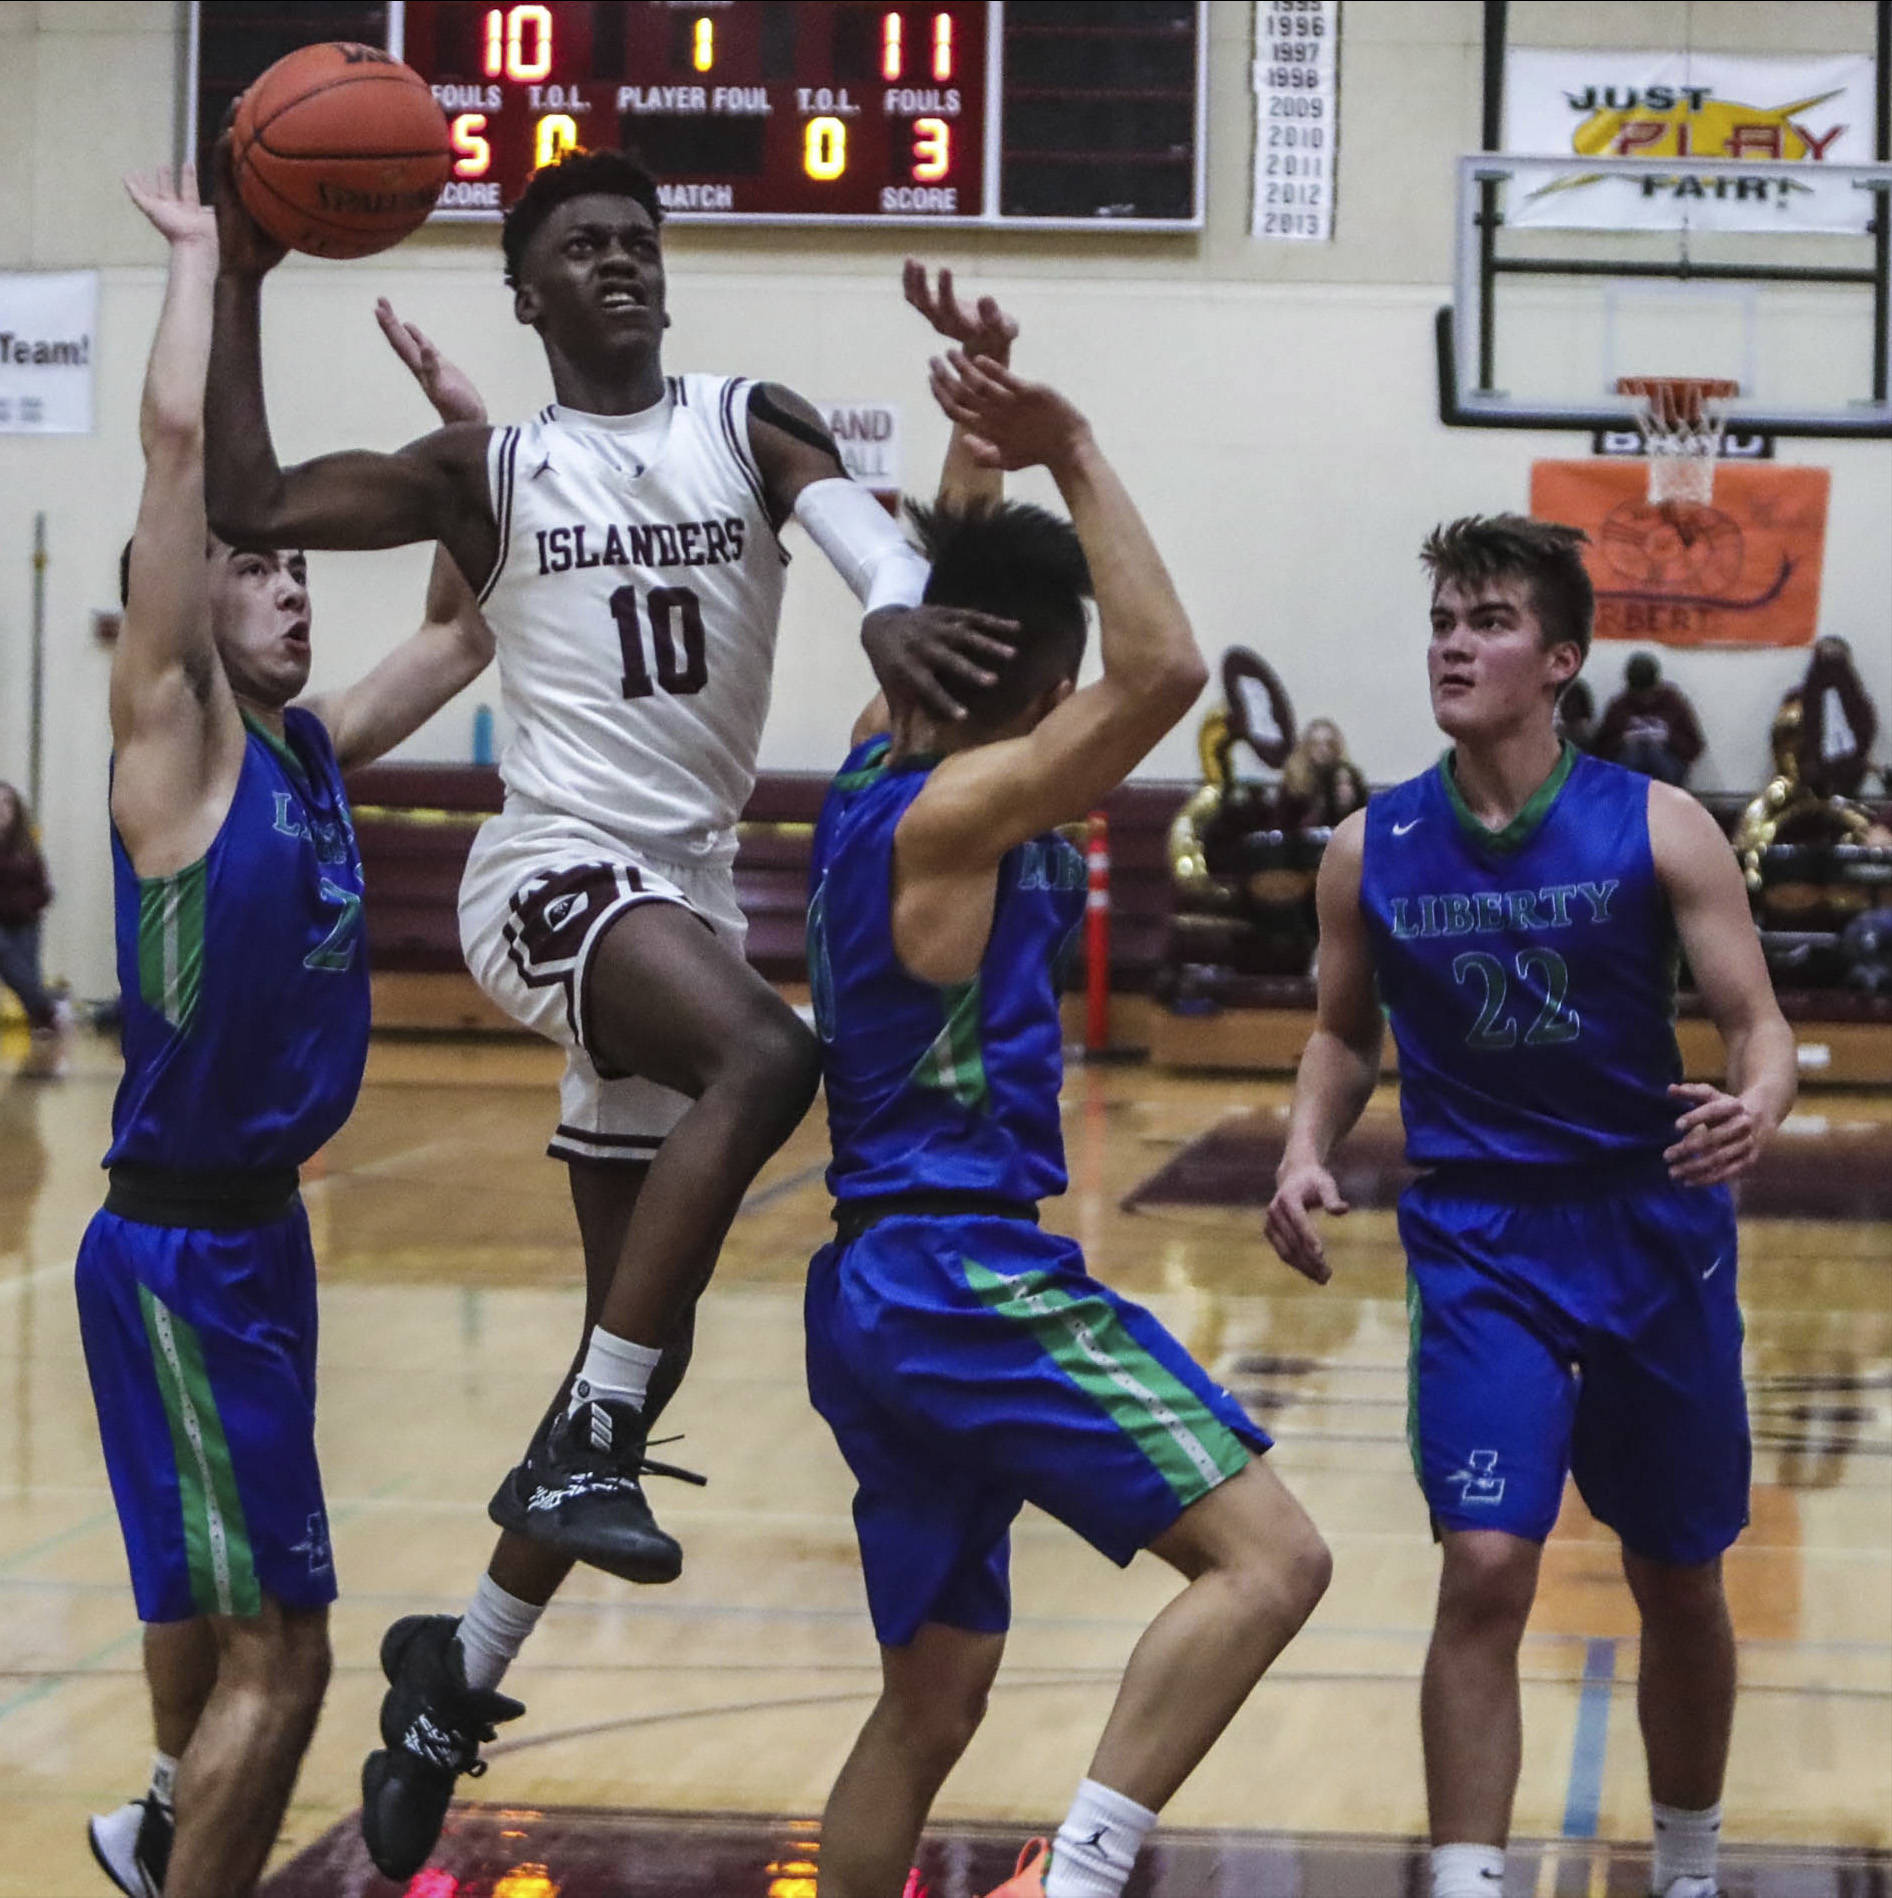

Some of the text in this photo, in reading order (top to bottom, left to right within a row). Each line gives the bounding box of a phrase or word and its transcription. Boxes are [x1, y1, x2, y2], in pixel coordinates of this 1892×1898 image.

[1268, 16, 1324, 37] 1996
[484, 4, 552, 81] 10
[693, 17, 713, 72] 1
[883, 12, 951, 81] 11
[1273, 43, 1319, 62] 1997
[1267, 68, 1318, 88] 1998
[431, 84, 502, 112] FOULS
[528, 84, 592, 112] T.O.L.
[617, 86, 773, 116] PLAYER FOUL
[796, 88, 861, 114] T.O.L.
[884, 88, 961, 115] FOULS
[1268, 96, 1324, 118] 2009
[1568, 86, 1712, 112] JUST
[449, 113, 490, 177] 5
[804, 117, 846, 180] 0
[911, 118, 950, 182] 3
[1269, 126, 1324, 148] 2010
[1266, 154, 1322, 176] 2011
[435, 182, 500, 206] CORE
[880, 186, 957, 212] SCORE
[1266, 182, 1321, 205] 2012
[1642, 174, 1790, 209] FAIR!
[1264, 213, 1319, 234] 2013
[0, 331, 89, 365] Team!
[536, 518, 745, 575] ISLANDERS
[610, 584, 708, 699] 10
[1391, 880, 1619, 939] LIBERTY
[1453, 947, 1580, 1048] 22
